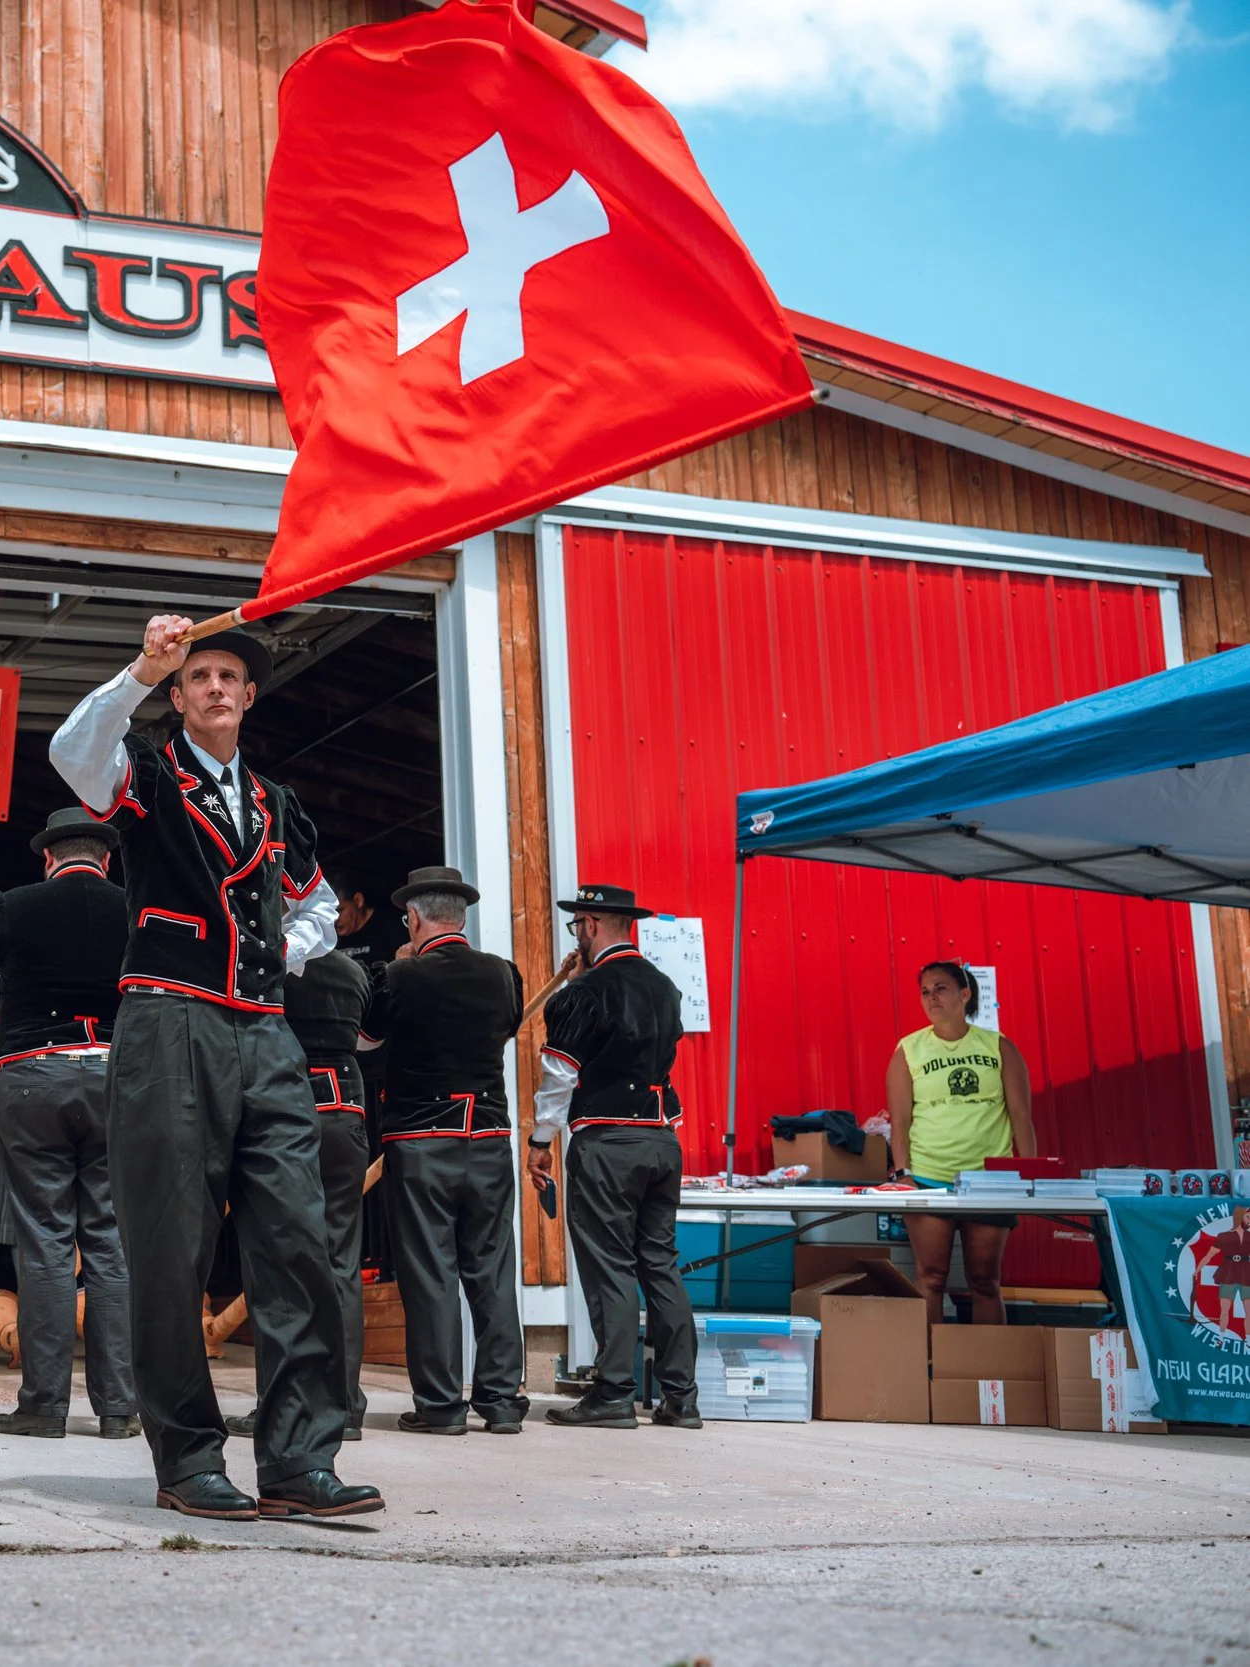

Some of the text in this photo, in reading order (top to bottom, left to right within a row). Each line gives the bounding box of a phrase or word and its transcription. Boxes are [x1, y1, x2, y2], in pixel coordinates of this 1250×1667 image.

[922, 1054, 999, 1075] VOLUNTEER
[878, 1216, 890, 1231] 5
[1195, 1202, 1230, 1228] NEW
[1157, 1358, 1191, 1382] NEW
